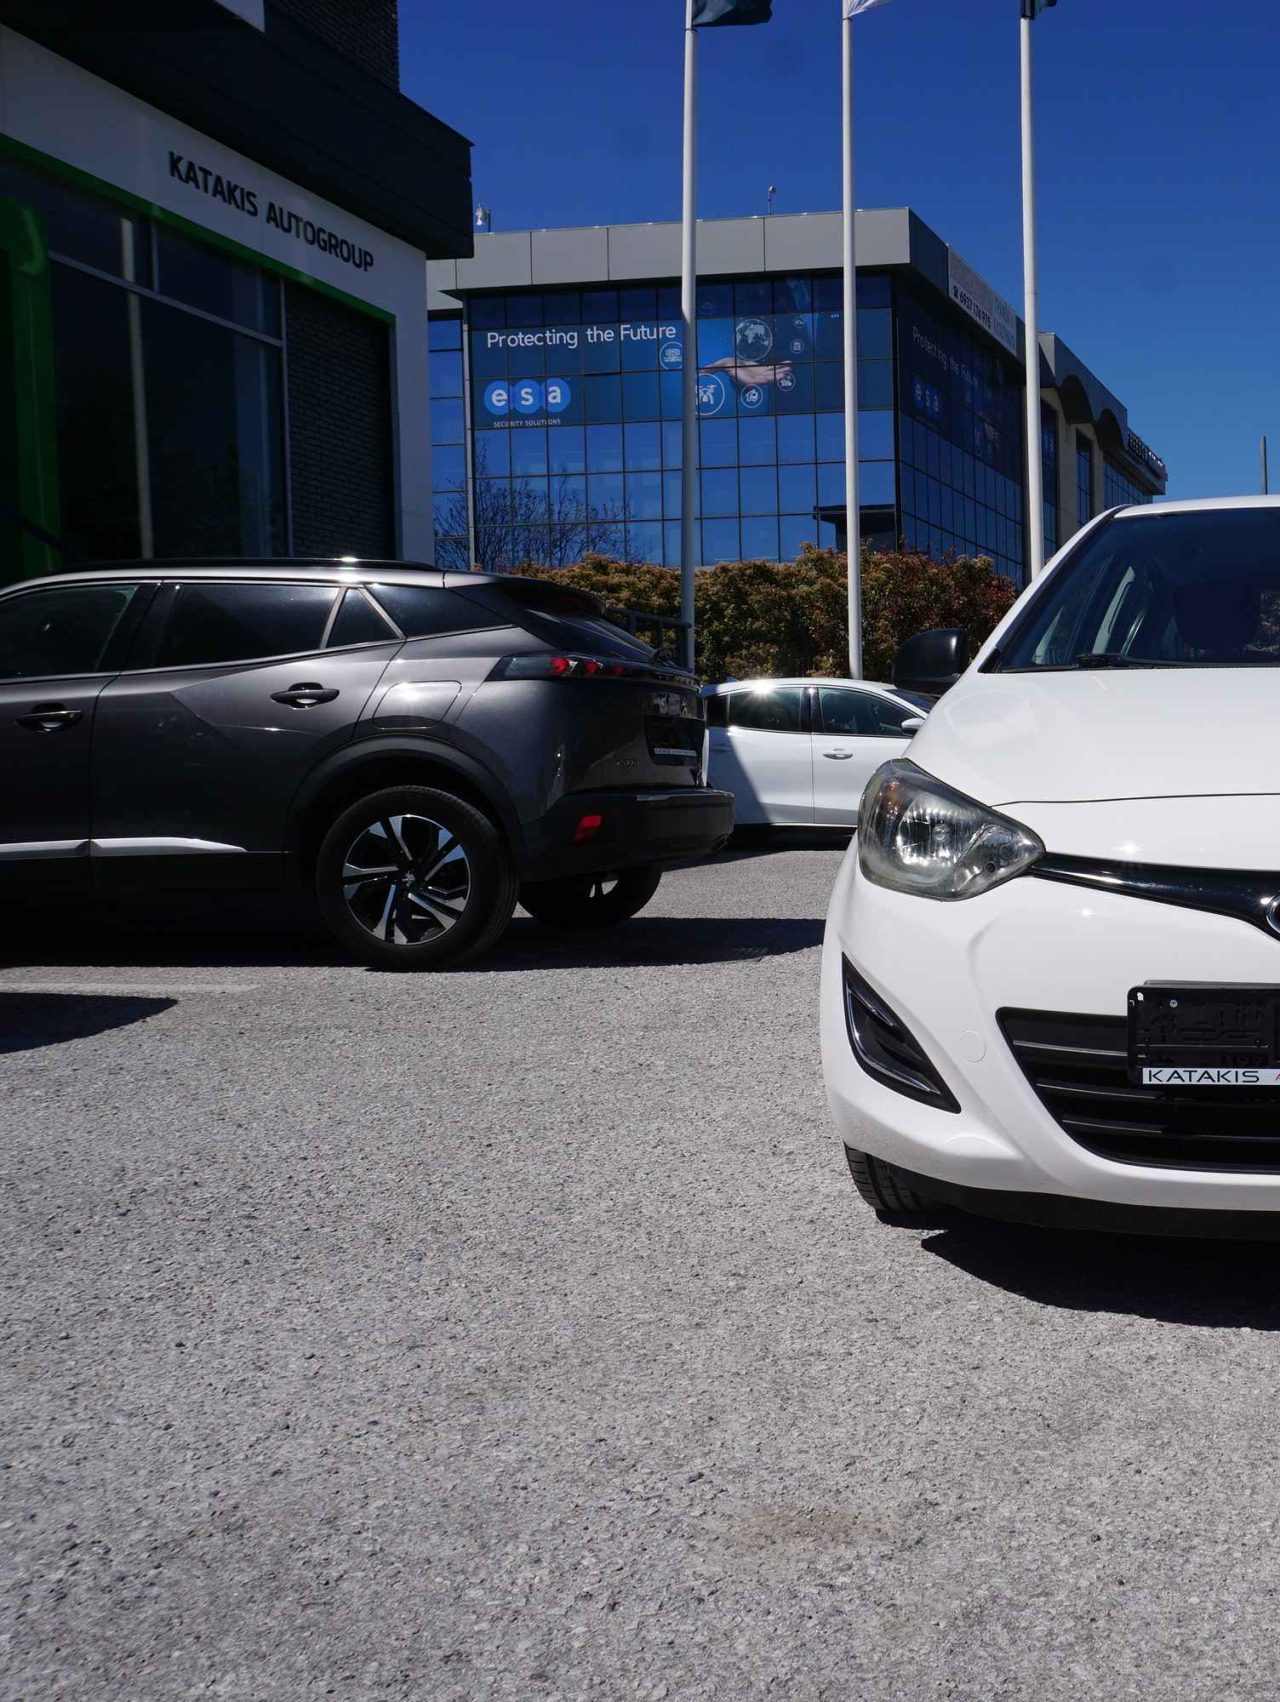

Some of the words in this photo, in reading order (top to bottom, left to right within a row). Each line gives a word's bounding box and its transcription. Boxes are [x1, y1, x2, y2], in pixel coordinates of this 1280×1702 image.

[168, 150, 258, 217] KATAKIS
[265, 201, 374, 272] AUTOGROUP
[486, 329, 579, 349] Protecting
[586, 325, 615, 344] the
[620, 324, 676, 341] Future
[493, 420, 523, 429] SECURITY
[525, 417, 561, 427] SOLUTIONS
[1148, 1069, 1260, 1083] KATAKIS
